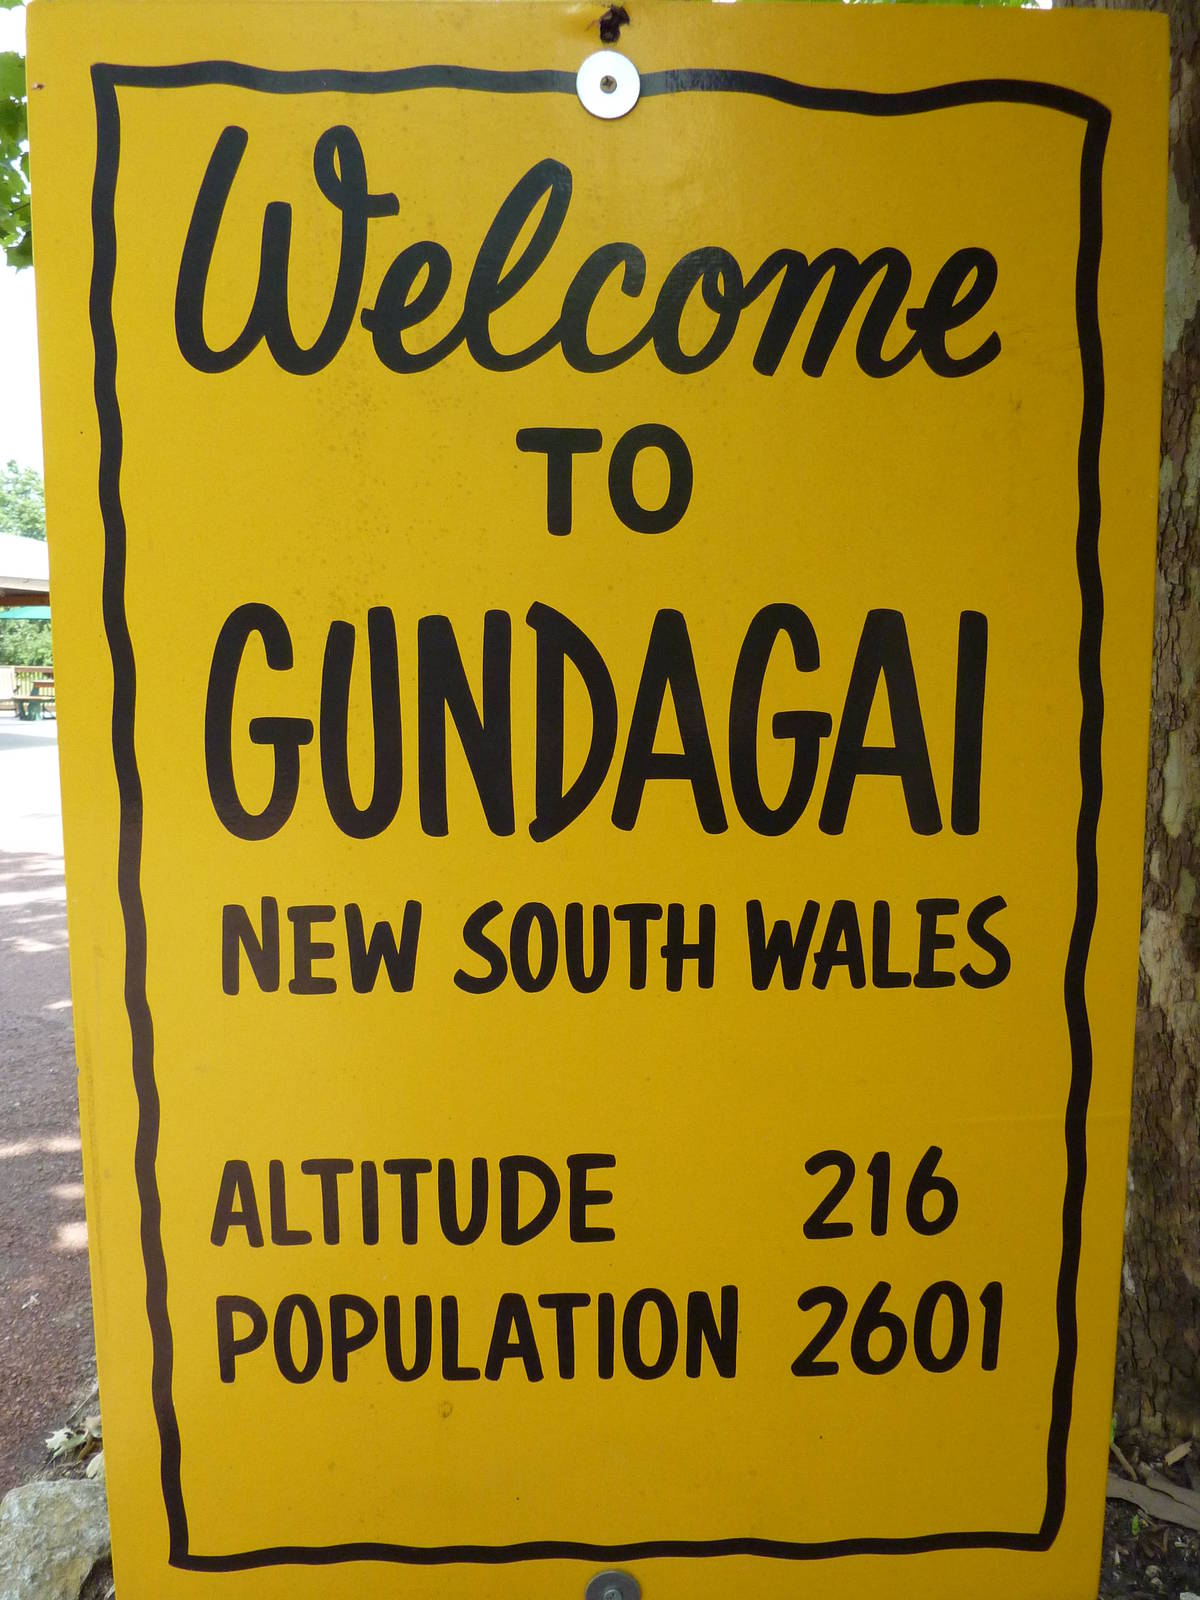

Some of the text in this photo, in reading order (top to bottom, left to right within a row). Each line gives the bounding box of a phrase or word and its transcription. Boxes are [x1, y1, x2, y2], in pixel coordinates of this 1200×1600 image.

[175, 125, 1001, 378] Welcome
[516, 424, 693, 536] TO
[205, 601, 988, 842] GUNDAGAI
[222, 895, 1011, 995] NEW SOUTH WALES
[211, 1146, 958, 1247] ALTITUDE 216
[216, 1281, 1002, 1384] POPULATION 2601
